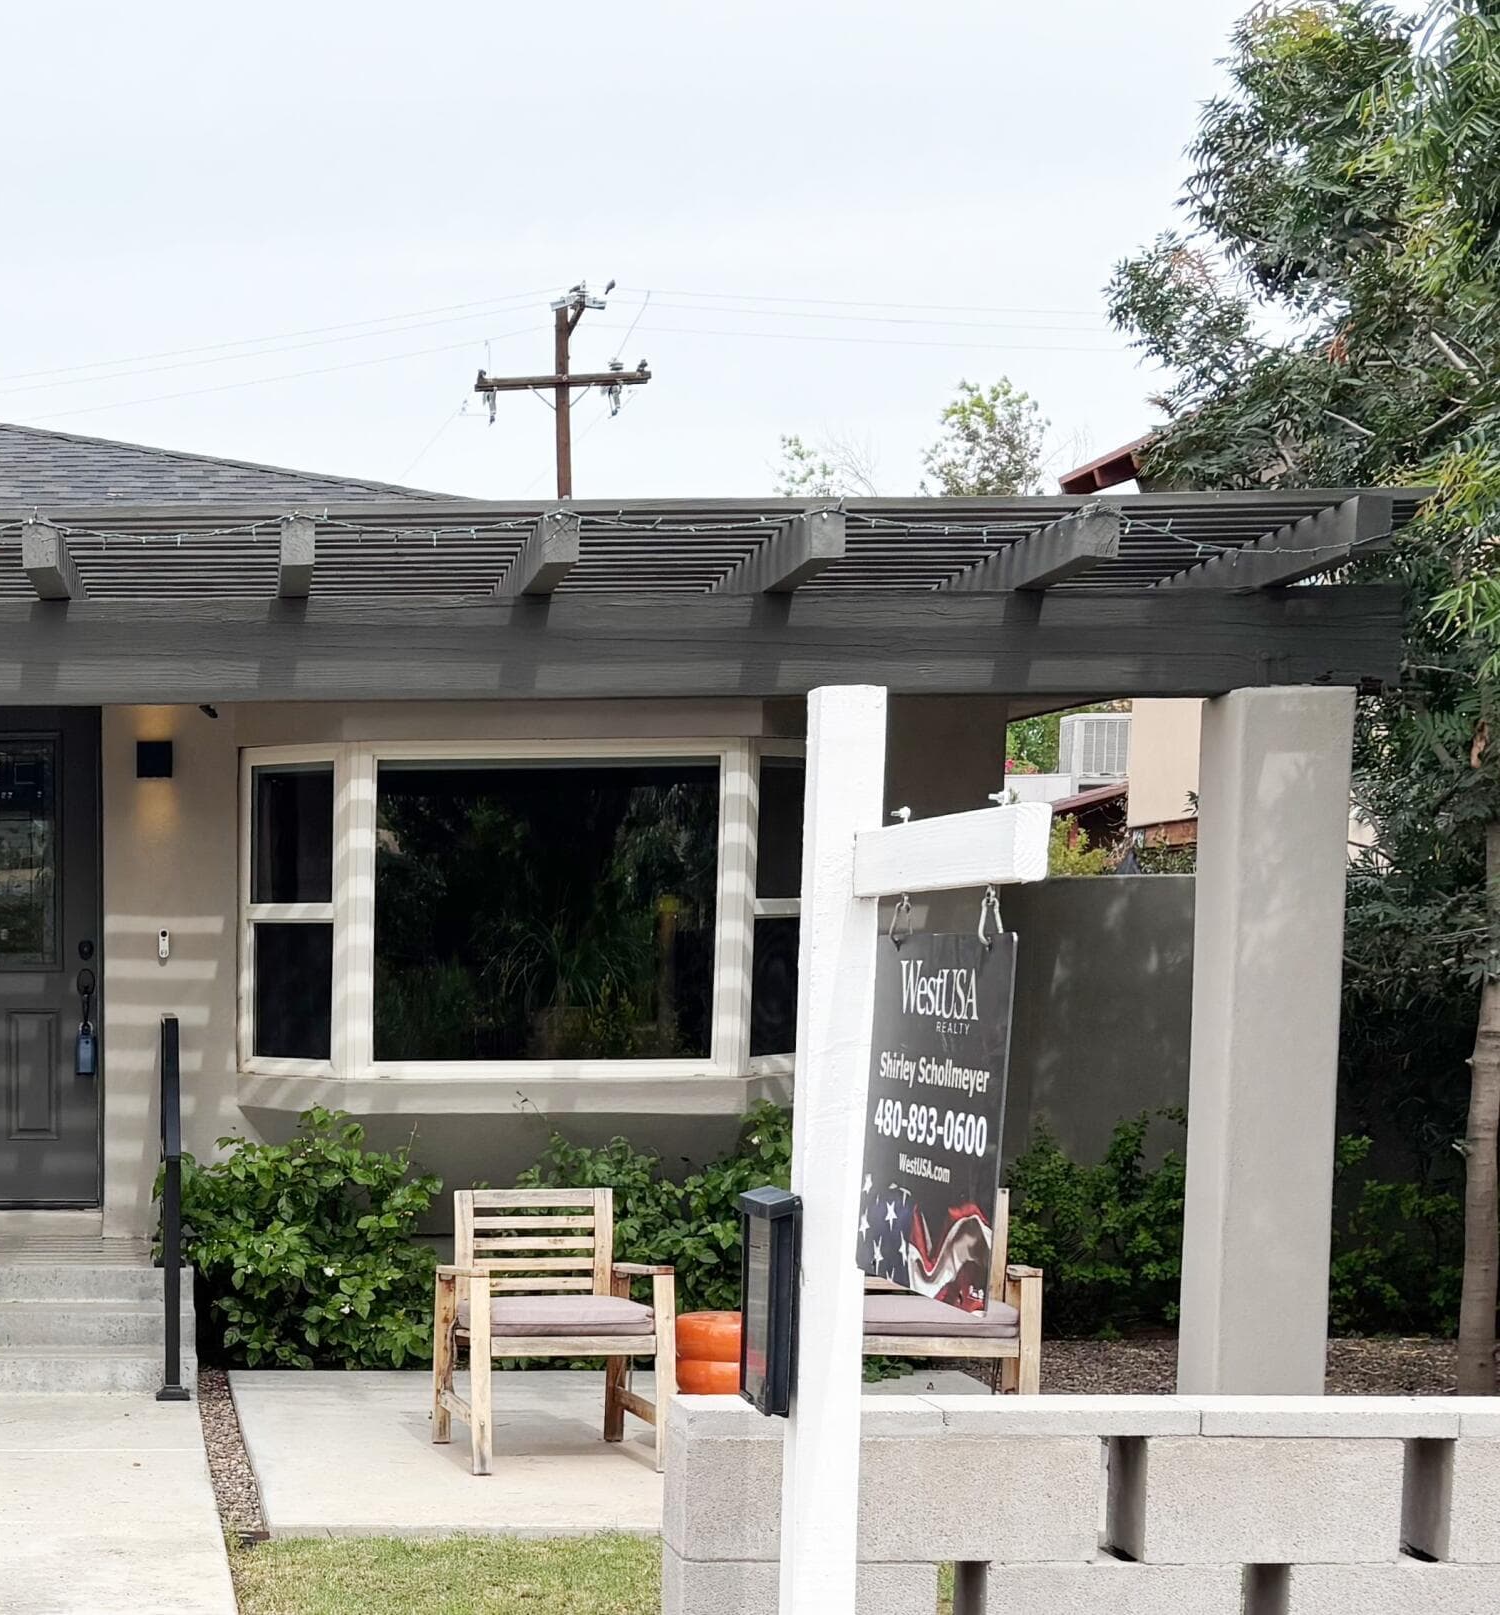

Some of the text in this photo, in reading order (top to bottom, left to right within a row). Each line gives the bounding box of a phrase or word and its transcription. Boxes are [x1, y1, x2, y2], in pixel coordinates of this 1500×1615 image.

[900, 960, 979, 1020] WestUSA
[936, 1021, 970, 1035] REALTY
[880, 1051, 990, 1098] Shirley Schollmeyer
[874, 1098, 987, 1157] 480-893-0600
[899, 1153, 950, 1183] WestUSA.com
